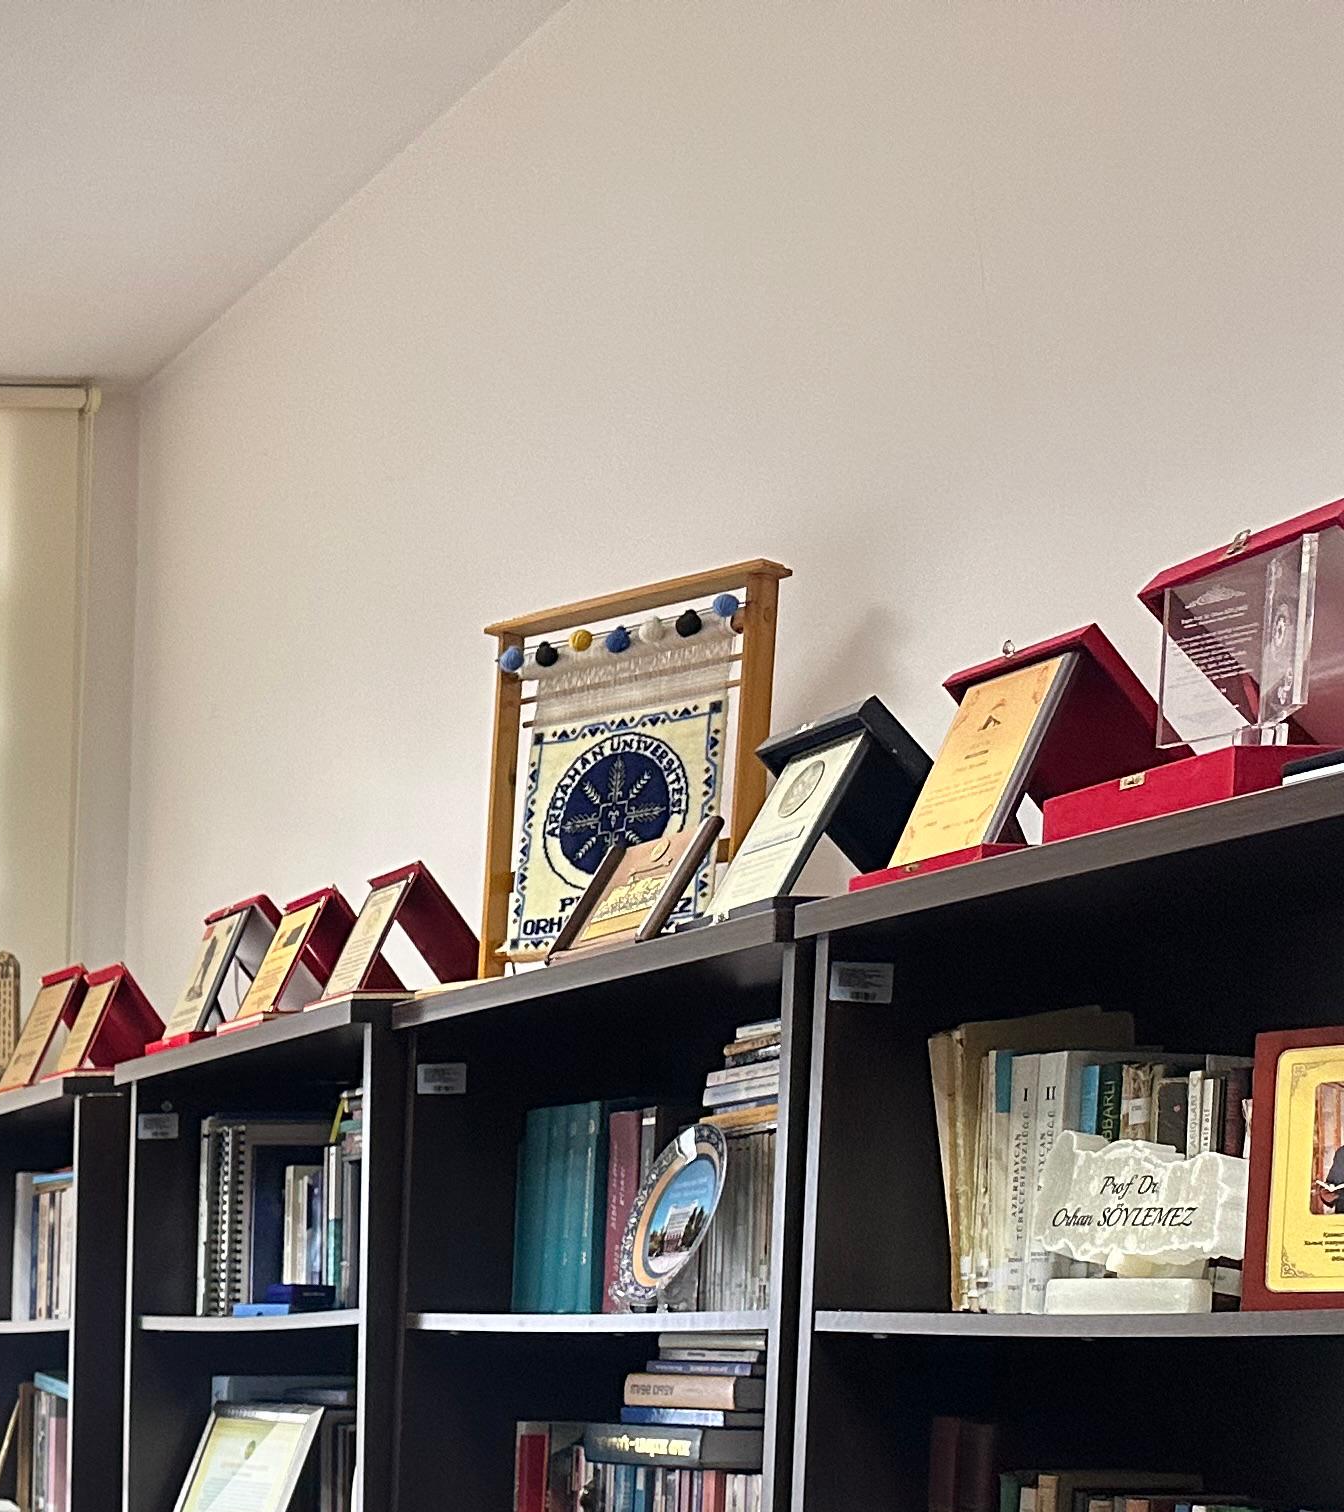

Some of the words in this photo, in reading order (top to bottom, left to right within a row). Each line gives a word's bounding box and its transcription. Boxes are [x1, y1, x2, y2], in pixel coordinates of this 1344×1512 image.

[546, 745, 605, 838] ARDAHAN
[523, 915, 568, 936] ORH
[1102, 1080, 1116, 1142] BBARLI
[1052, 1207, 1094, 1228] Orhan
[1097, 1203, 1198, 1228] SÖYLEMEZ
